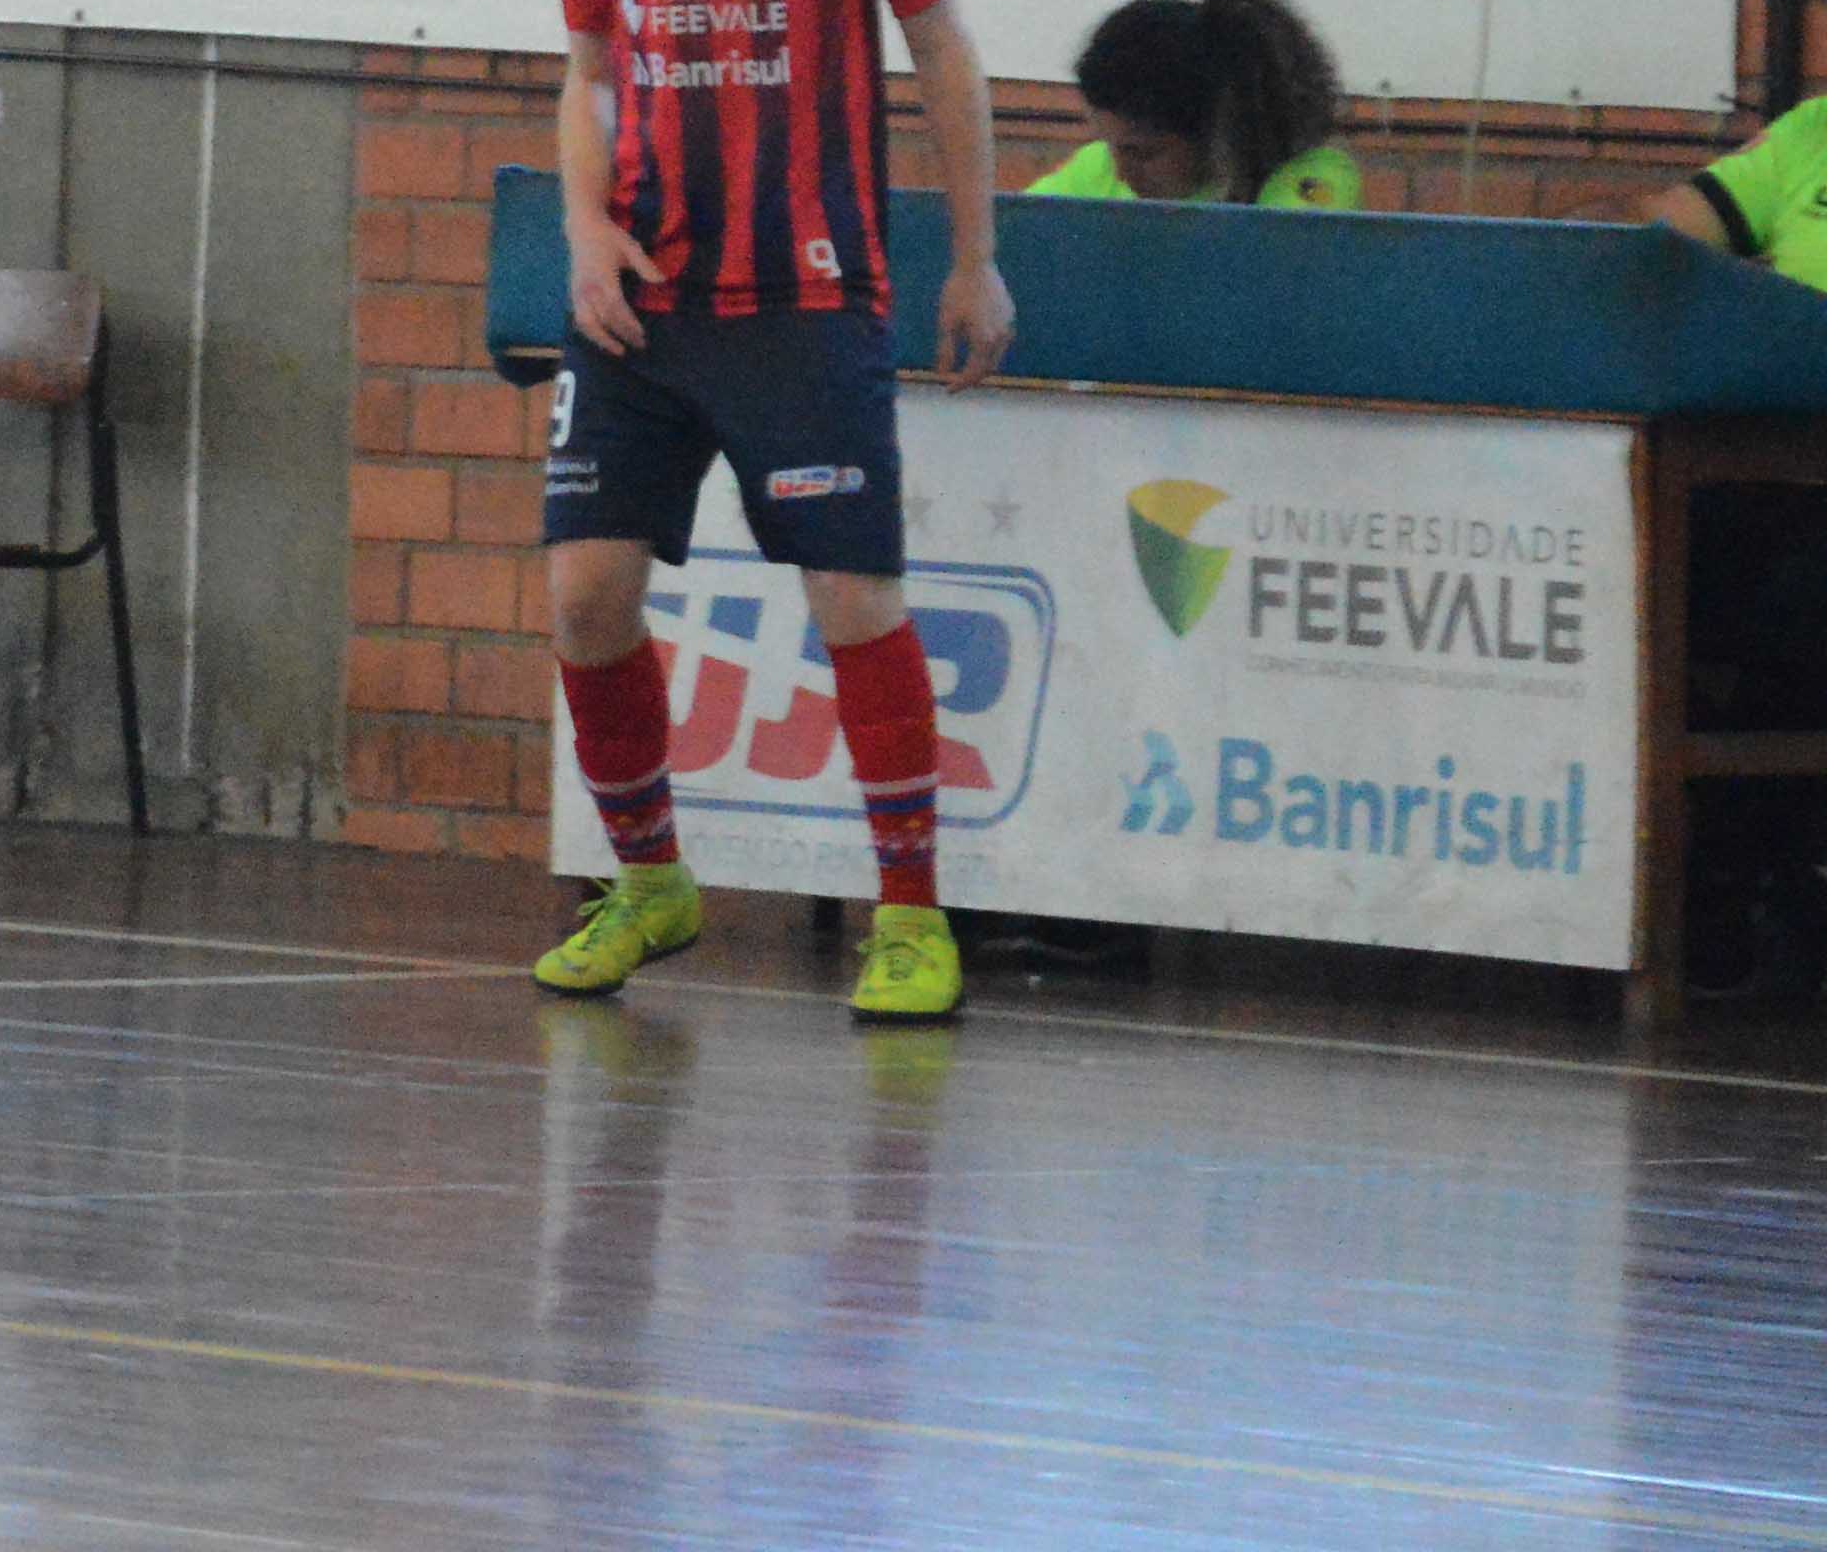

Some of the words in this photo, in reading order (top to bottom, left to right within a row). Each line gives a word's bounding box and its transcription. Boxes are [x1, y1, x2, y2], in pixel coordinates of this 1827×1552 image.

[651, 3, 788, 35] FEEVALE
[649, 46, 791, 88] Banrisul
[1250, 504, 1587, 568] UNIVERSIDADE
[1249, 556, 1587, 664] FEEVALE
[1215, 737, 1587, 875] Banrisul
